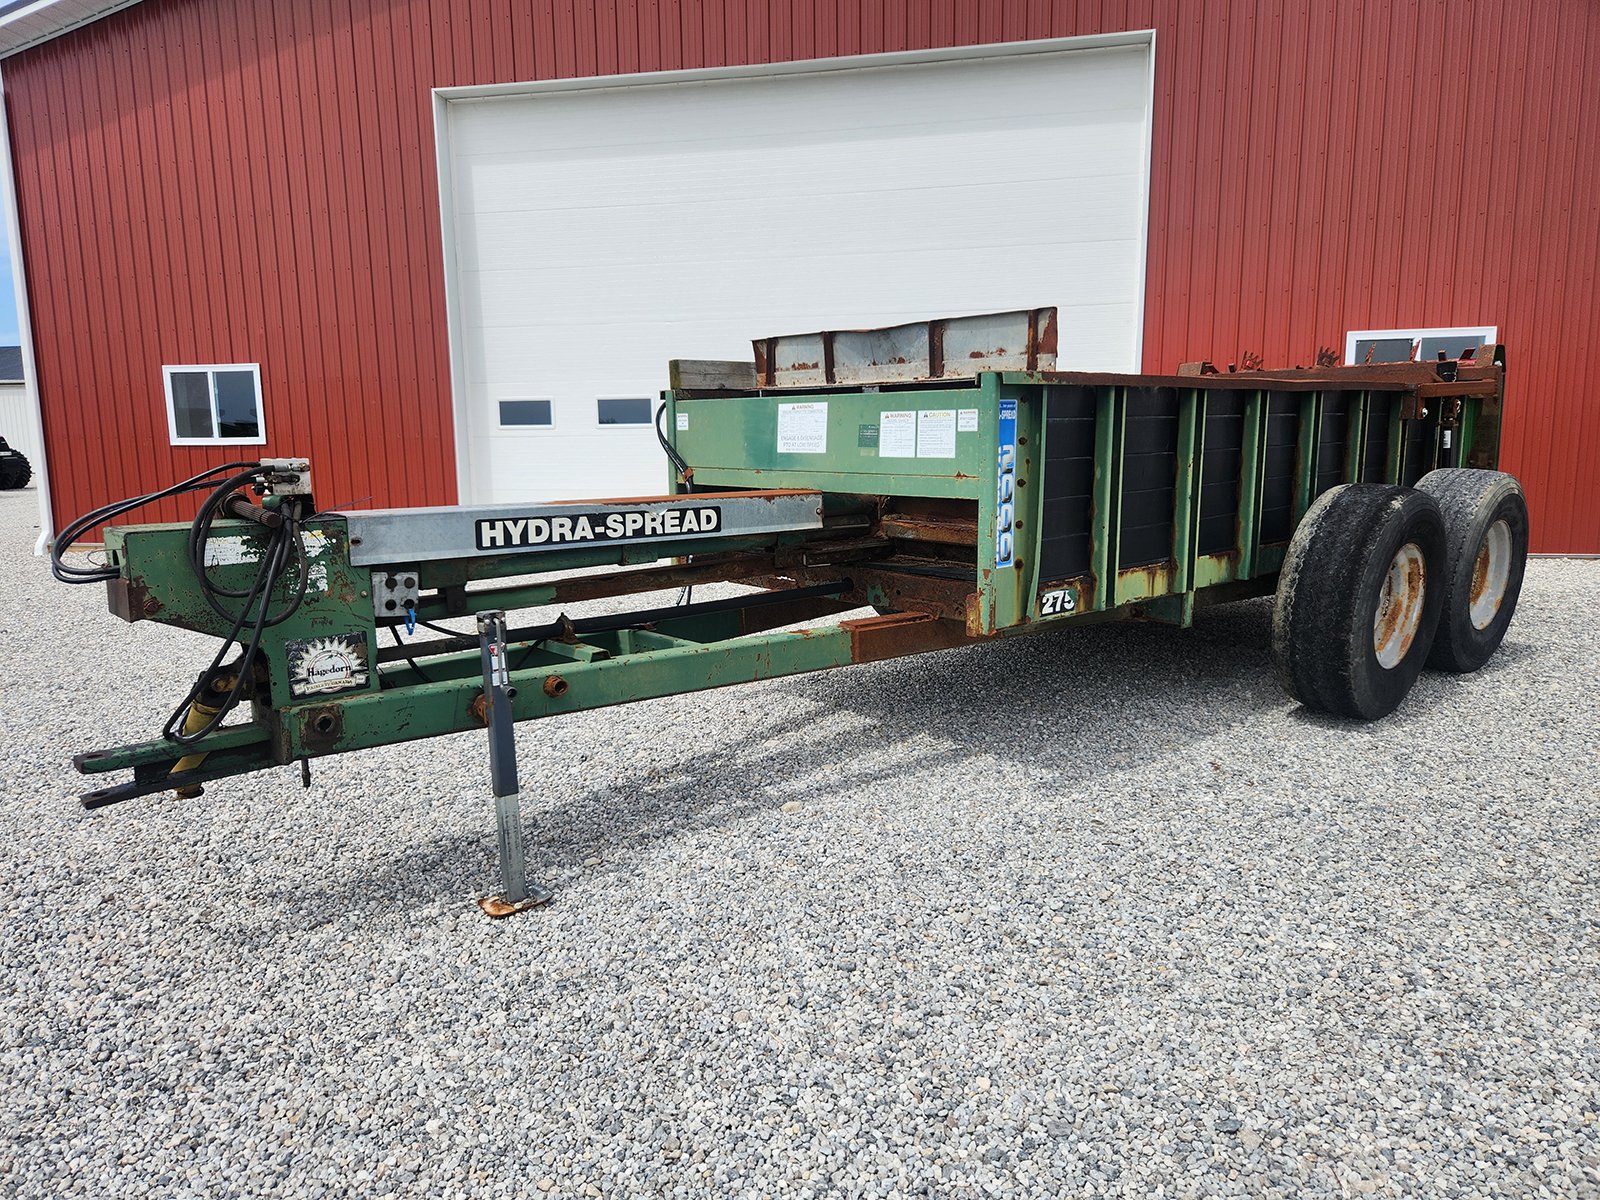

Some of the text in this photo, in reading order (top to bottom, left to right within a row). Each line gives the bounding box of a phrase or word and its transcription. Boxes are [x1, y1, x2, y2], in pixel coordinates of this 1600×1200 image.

[1000, 444, 1014, 562] 2000
[480, 508, 718, 548] HYDRA-SPREAD
[1041, 589, 1075, 615] 275
[307, 664, 352, 678] Hagedorn
